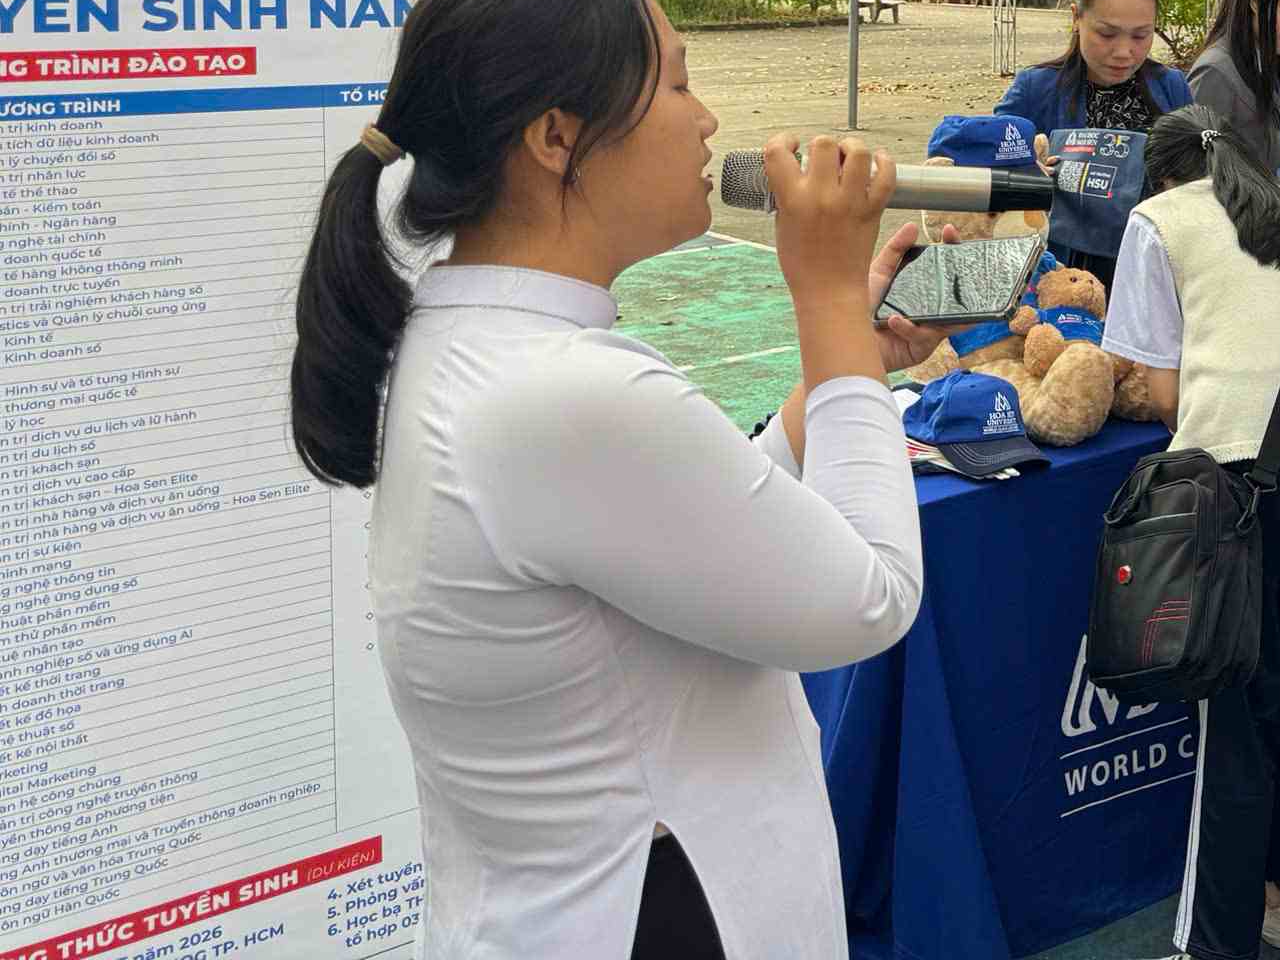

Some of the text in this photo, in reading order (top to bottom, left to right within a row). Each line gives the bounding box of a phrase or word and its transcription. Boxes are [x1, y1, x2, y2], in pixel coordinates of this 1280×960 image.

[36, 52, 120, 74] TRÌNH
[127, 52, 187, 72] ĐÀO
[194, 53, 246, 74] TẠO
[0, 97, 121, 116] ƯƠNG TRÌNH
[1100, 133, 1130, 158] 35
[1087, 177, 1109, 189] HSU
[0, 761, 48, 779] rketing
[28, 765, 96, 789] Marketing
[1064, 742, 1167, 795] WORLD
[328, 889, 342, 900] 4.
[347, 879, 374, 895] Xét
[328, 907, 340, 919] 5.
[346, 888, 397, 912] Phỏng
[58, 916, 135, 958] THỨC
[144, 890, 232, 932] TUYỂN
[239, 870, 299, 903] SINH
[328, 905, 400, 936] 6. Học bạ
[131, 944, 173, 960] năm
[180, 926, 222, 950] 2026
[212, 941, 238, 957] TP.
[244, 924, 284, 946] HCM
[346, 913, 419, 947] tổ hợp 03
